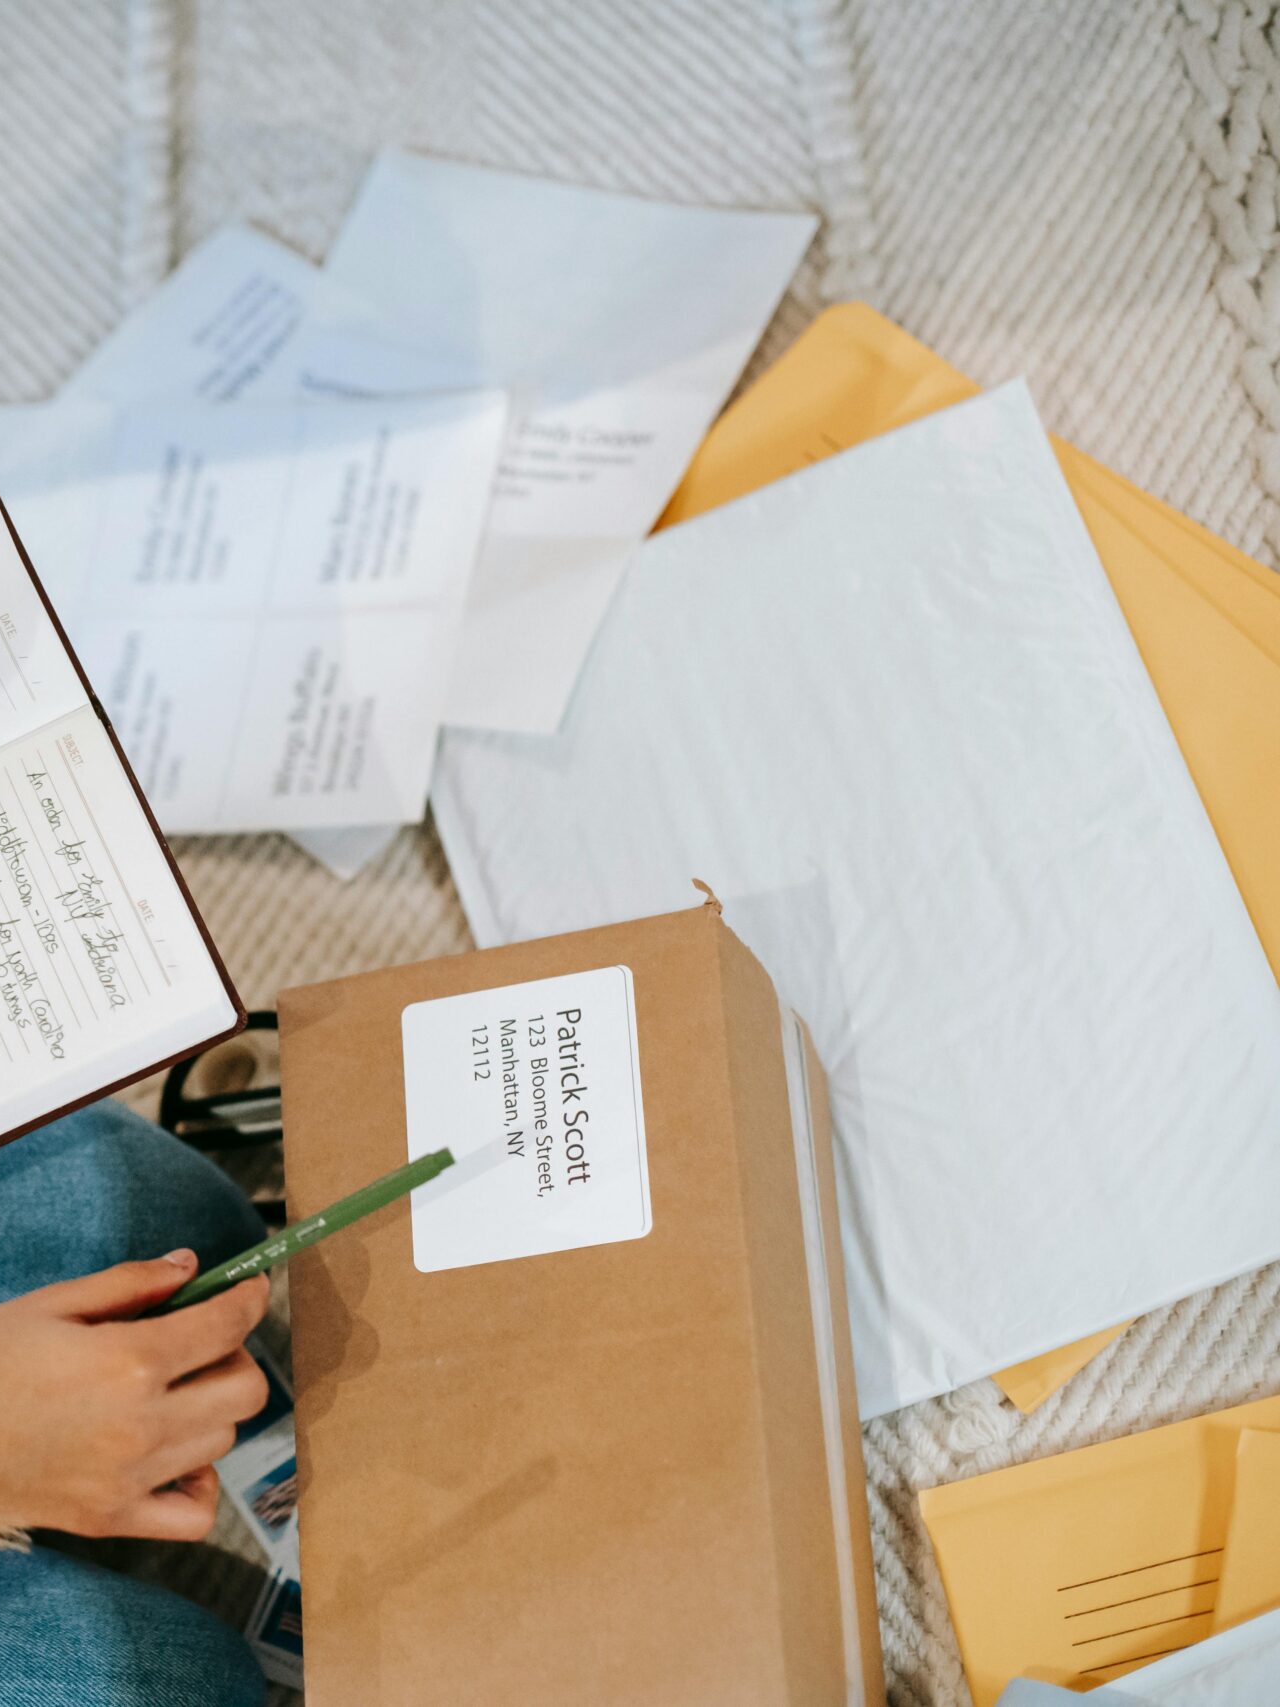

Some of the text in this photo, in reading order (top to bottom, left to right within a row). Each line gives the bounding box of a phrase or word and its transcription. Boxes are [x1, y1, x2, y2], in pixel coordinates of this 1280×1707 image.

[60, 732, 84, 769] SUBJECT:
[25, 771, 47, 790] An
[54, 839, 86, 866] for
[135, 897, 155, 923] DATE:
[471, 1024, 491, 1081] 12112
[499, 1019, 525, 1158] Manhattan, NY
[556, 1008, 591, 1186] Patrick Scott
[528, 1014, 555, 1198] 123 Bloome Street,
